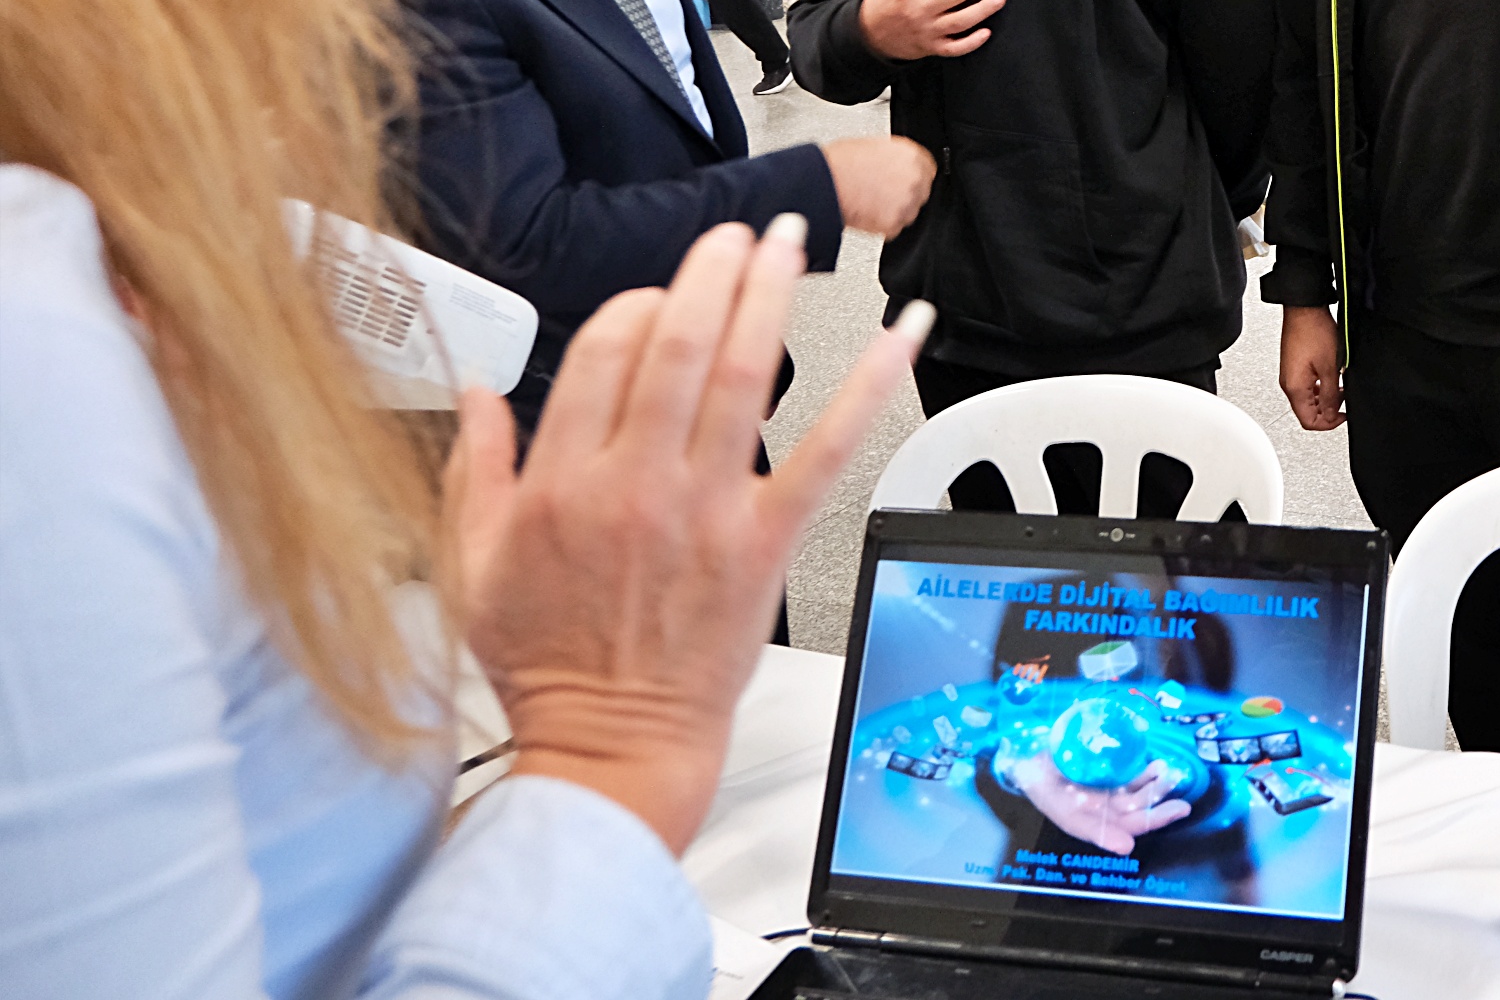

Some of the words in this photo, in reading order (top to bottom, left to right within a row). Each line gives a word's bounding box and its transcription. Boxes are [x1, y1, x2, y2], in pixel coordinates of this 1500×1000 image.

[917, 574, 1053, 604] AİLELERDE
[1059, 580, 1157, 612] DİJİTAL
[1163, 588, 1320, 619] BAĞIMLILIK
[1024, 609, 1197, 640] FARKINDALIK
[1061, 852, 1140, 874] CANDEMİR
[1070, 872, 1087, 885] ve
[1260, 949, 1314, 964] CASPER
